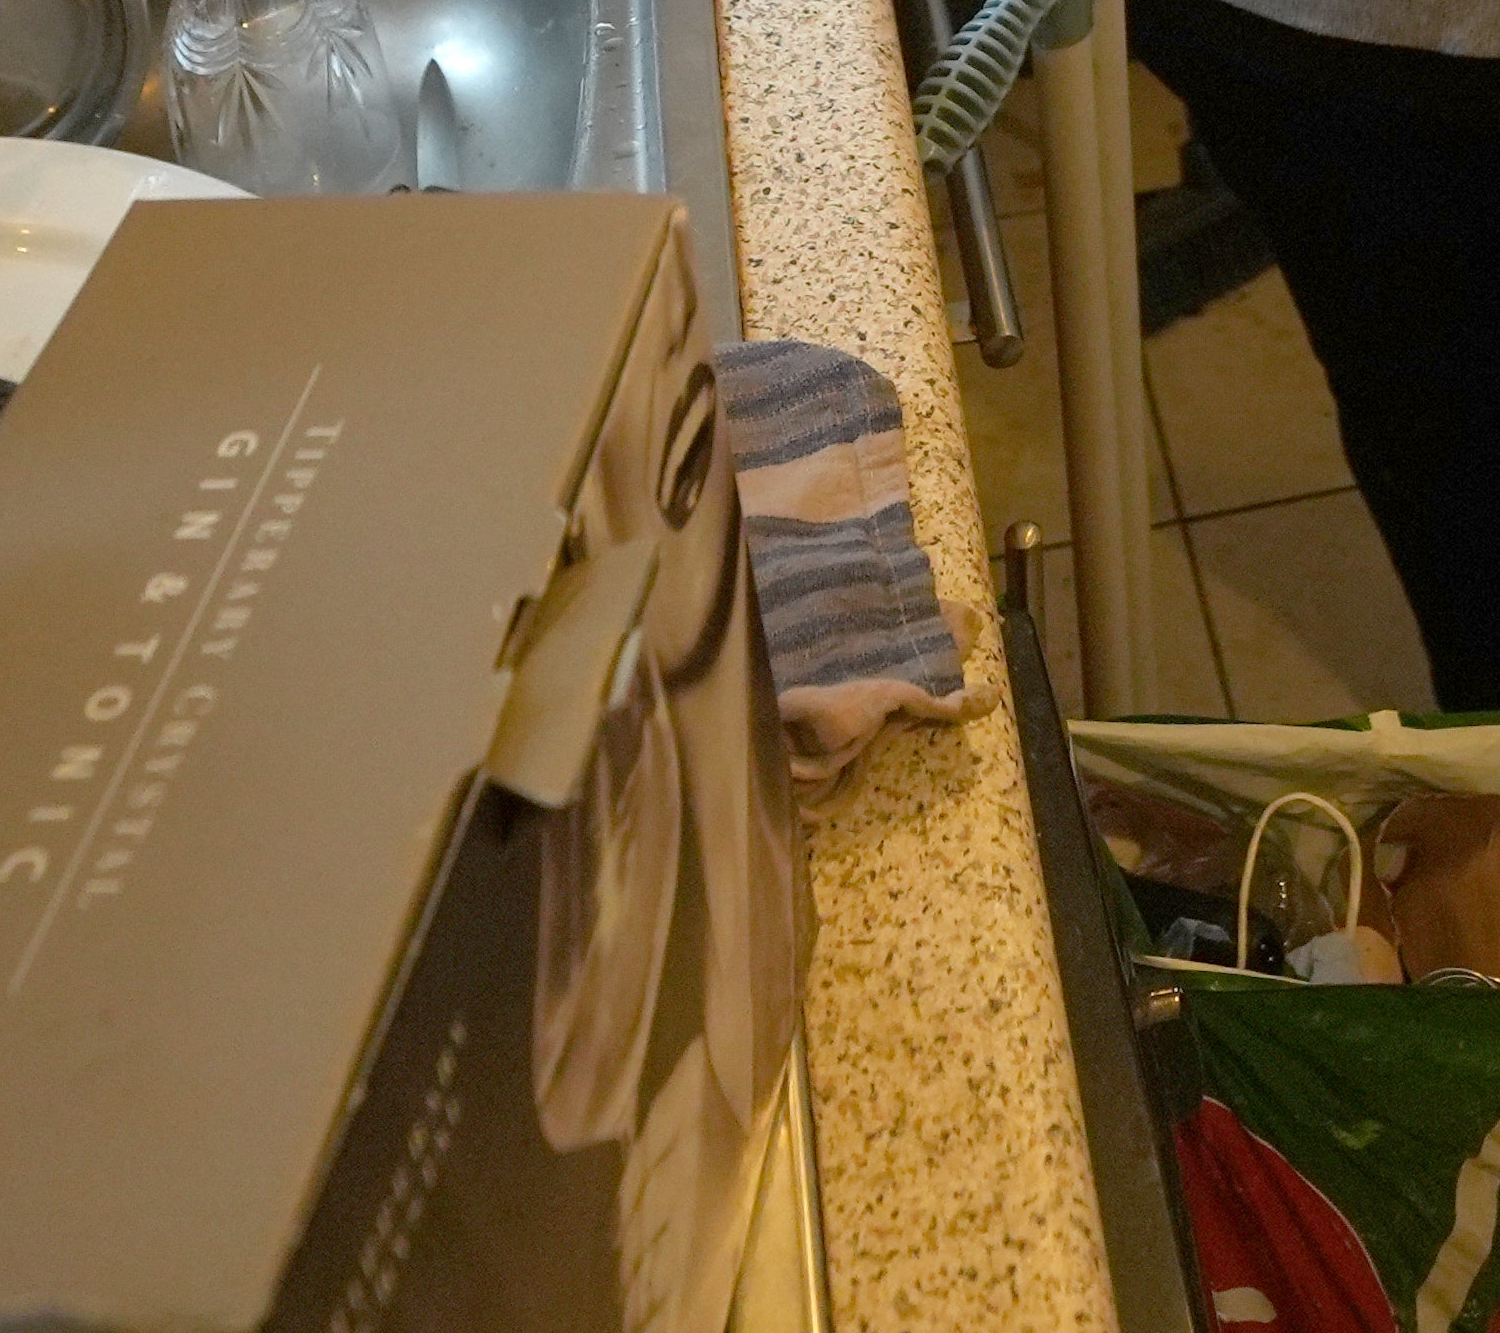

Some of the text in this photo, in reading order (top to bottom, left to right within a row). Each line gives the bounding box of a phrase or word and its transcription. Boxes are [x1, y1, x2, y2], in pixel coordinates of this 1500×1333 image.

[173, 429, 260, 541] GIN
[140, 571, 189, 603] &
[77, 419, 346, 911] TIPPERARY CRYSTAL
